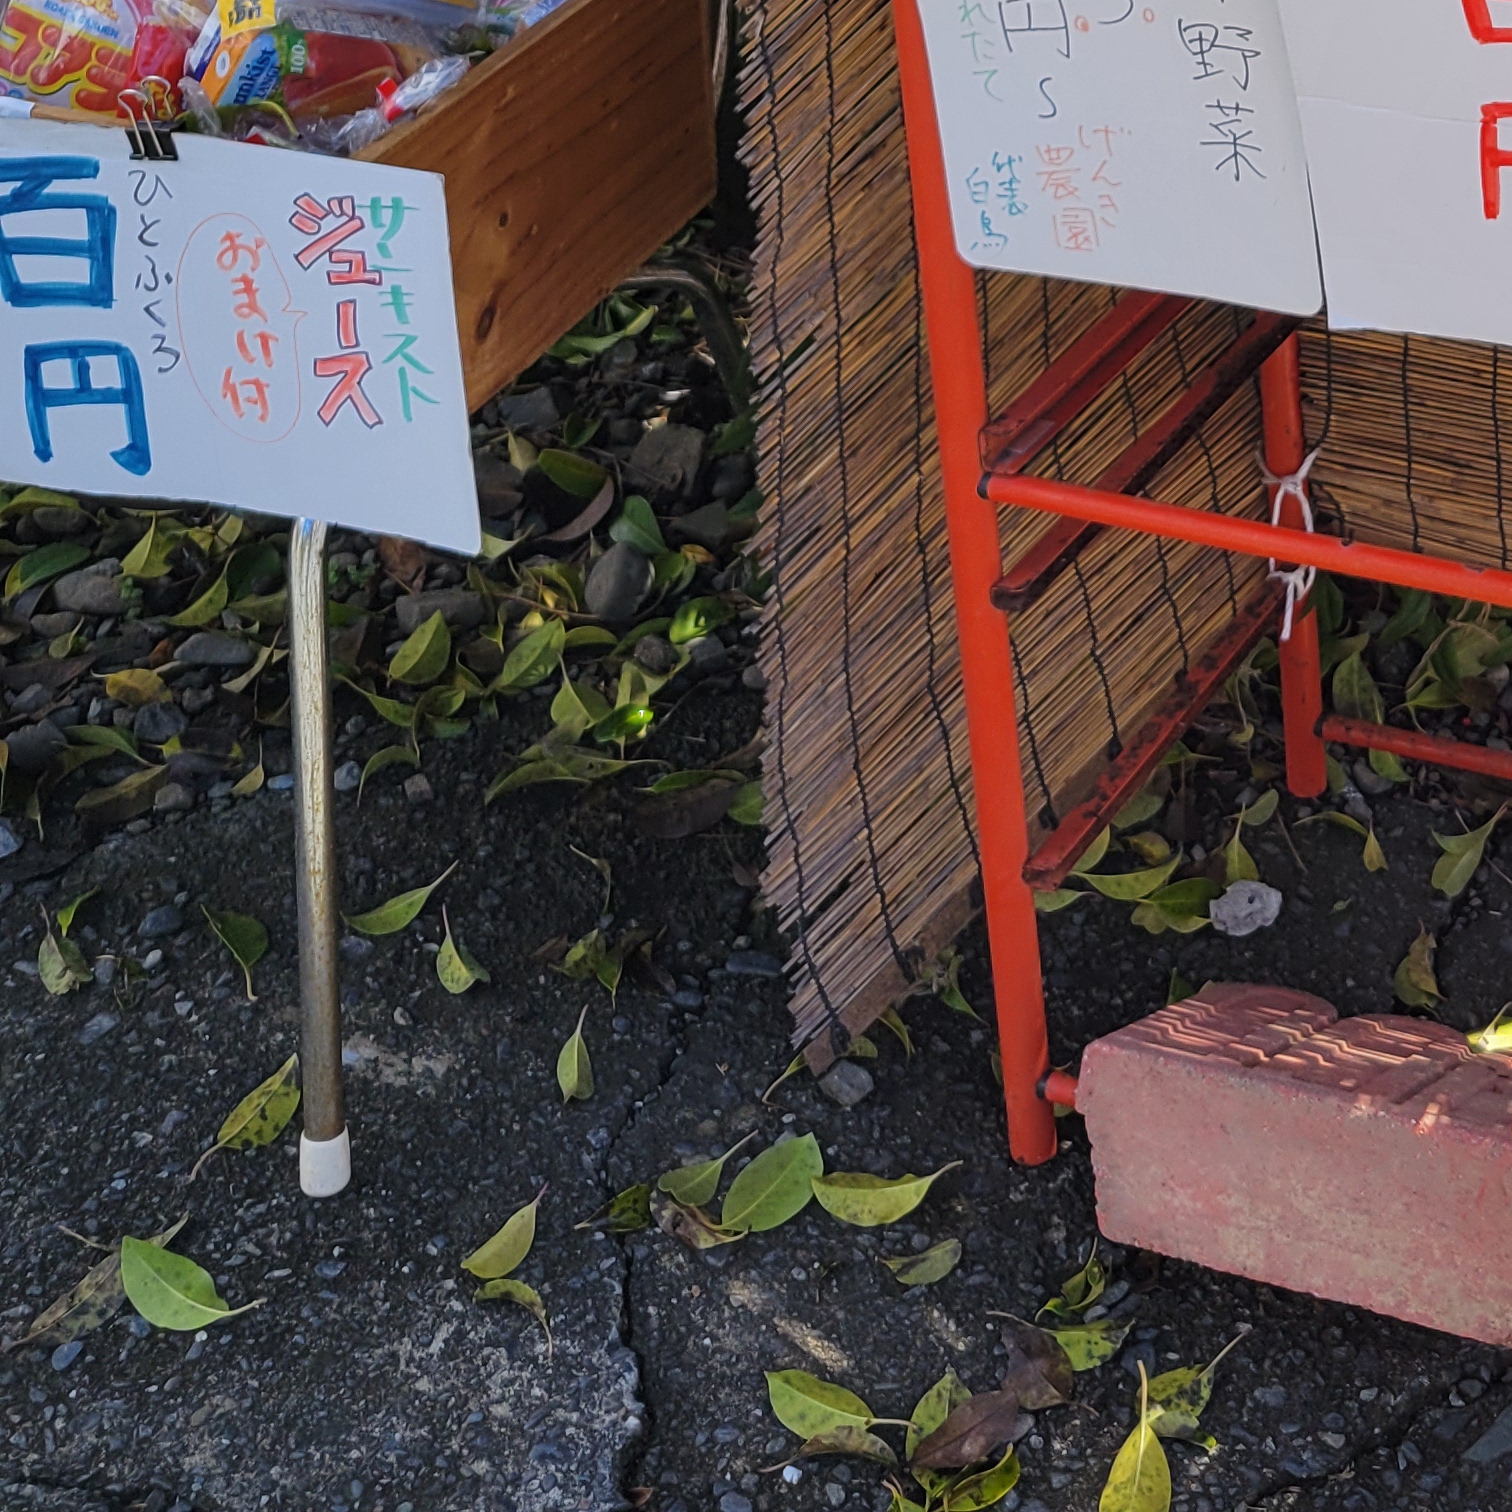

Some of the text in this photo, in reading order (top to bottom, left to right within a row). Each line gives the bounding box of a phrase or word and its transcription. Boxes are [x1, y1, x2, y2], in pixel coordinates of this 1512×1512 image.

[233, 44, 276, 106] unkist
[0, 155, 152, 477] 百円
[128, 169, 182, 374] ひとふくろ
[215, 229, 280, 423] おまけ付
[288, 191, 384, 429] ジュース
[355, 194, 441, 423] サンキスト
